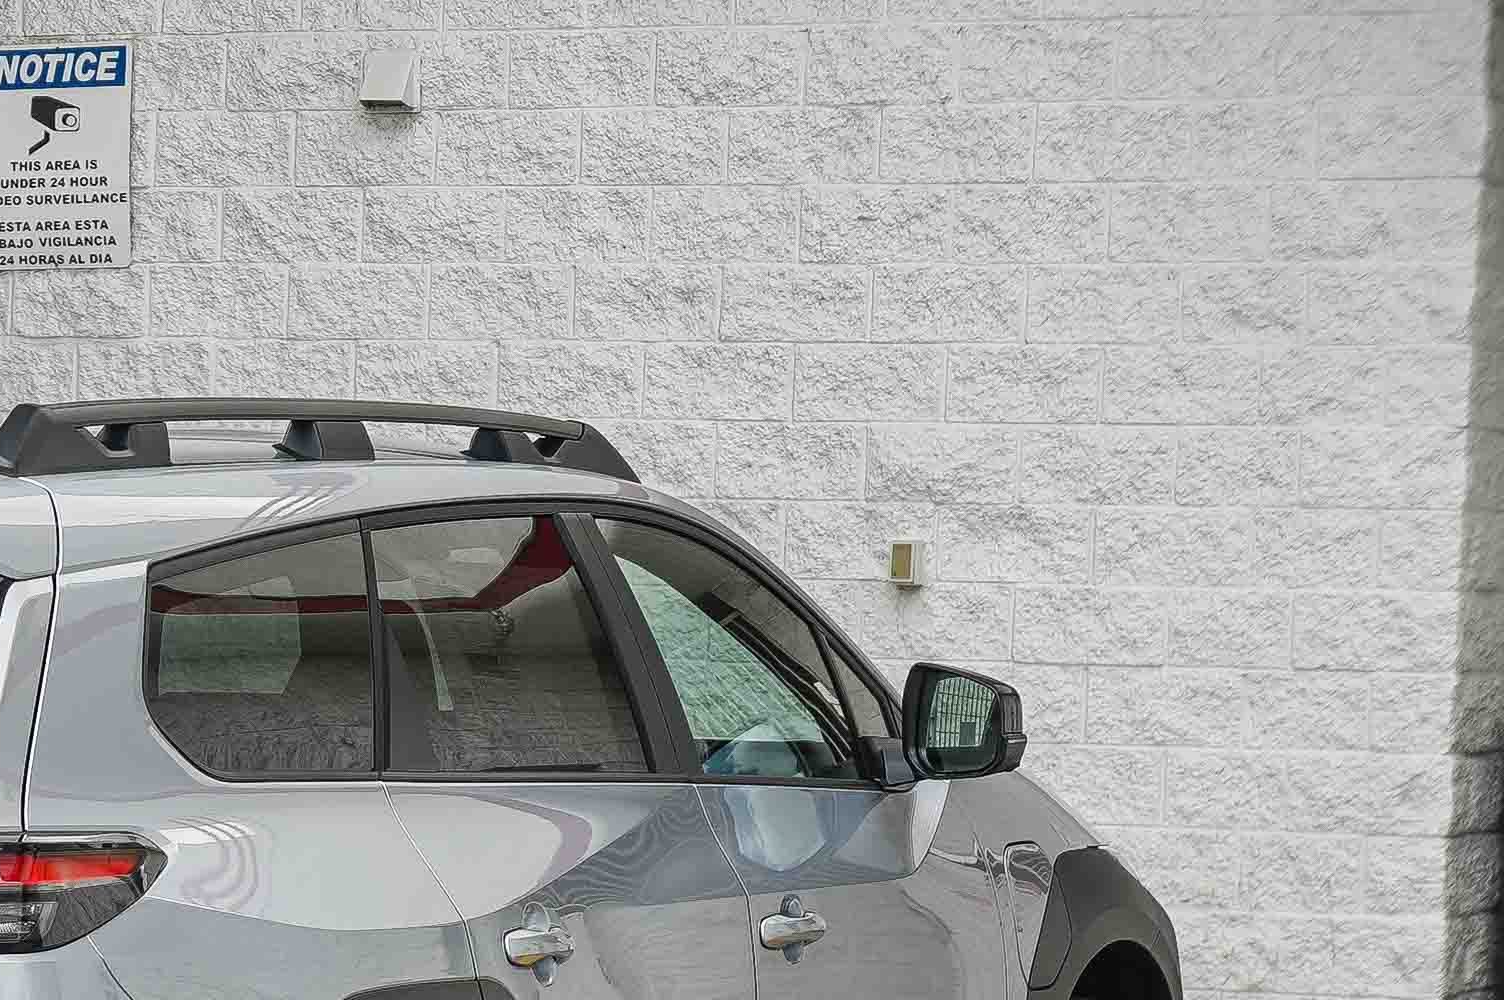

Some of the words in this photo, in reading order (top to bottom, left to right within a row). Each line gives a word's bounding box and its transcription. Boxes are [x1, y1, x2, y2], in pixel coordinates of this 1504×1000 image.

[10, 161, 41, 172] THIS
[45, 160, 81, 171] AREA
[85, 159, 98, 170] IS
[0, 178, 46, 189] UNDER
[50, 177, 66, 188] 24
[70, 176, 108, 187] HOUR
[26, 193, 127, 206] SURVEILLANCE
[35, 221, 71, 232] AREA
[75, 219, 109, 231] ESTA
[39, 236, 117, 248] VIGILANCIA
[0, 255, 14, 265] 24
[19, 254, 65, 266] HORAS
[69, 254, 85, 265] AL
[90, 253, 113, 264] DIA
